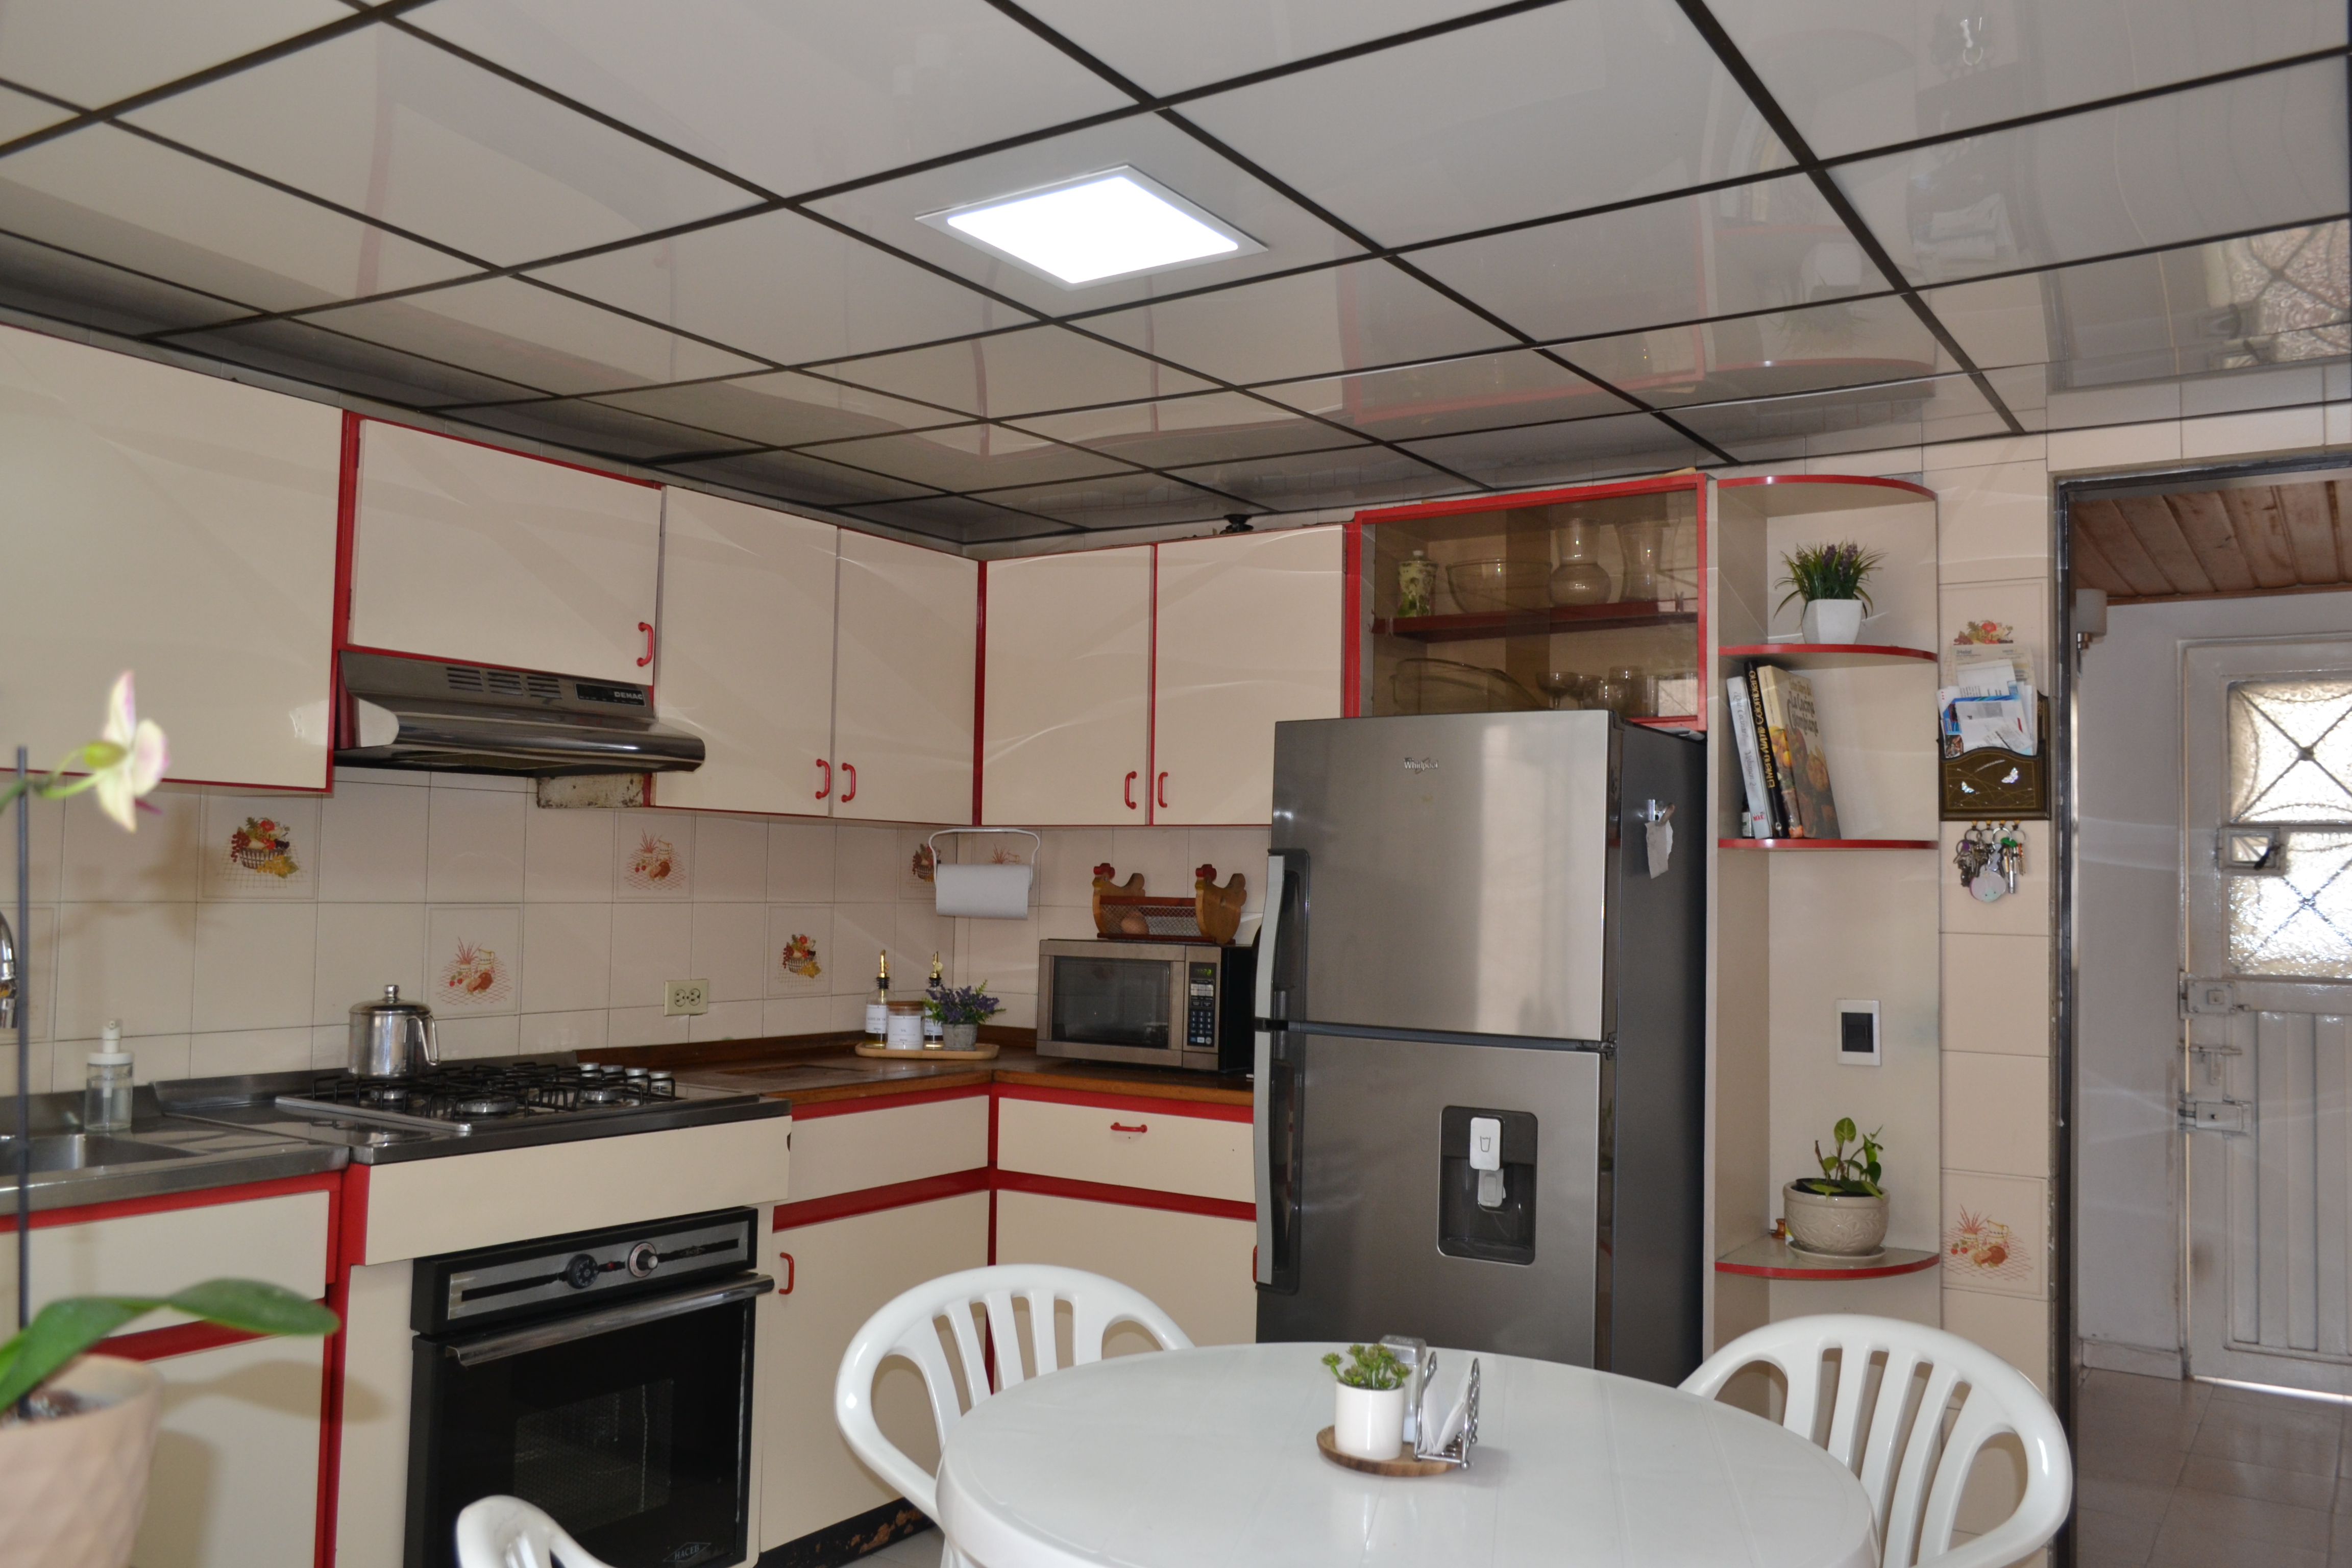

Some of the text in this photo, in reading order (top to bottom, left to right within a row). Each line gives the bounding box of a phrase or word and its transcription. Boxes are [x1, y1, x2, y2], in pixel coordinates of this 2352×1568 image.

[1404, 761, 1438, 771] Whirlpool
[1744, 750, 1755, 780] Volumen
[1767, 779, 1775, 789] El
[674, 1545, 700, 1560] HACEB
